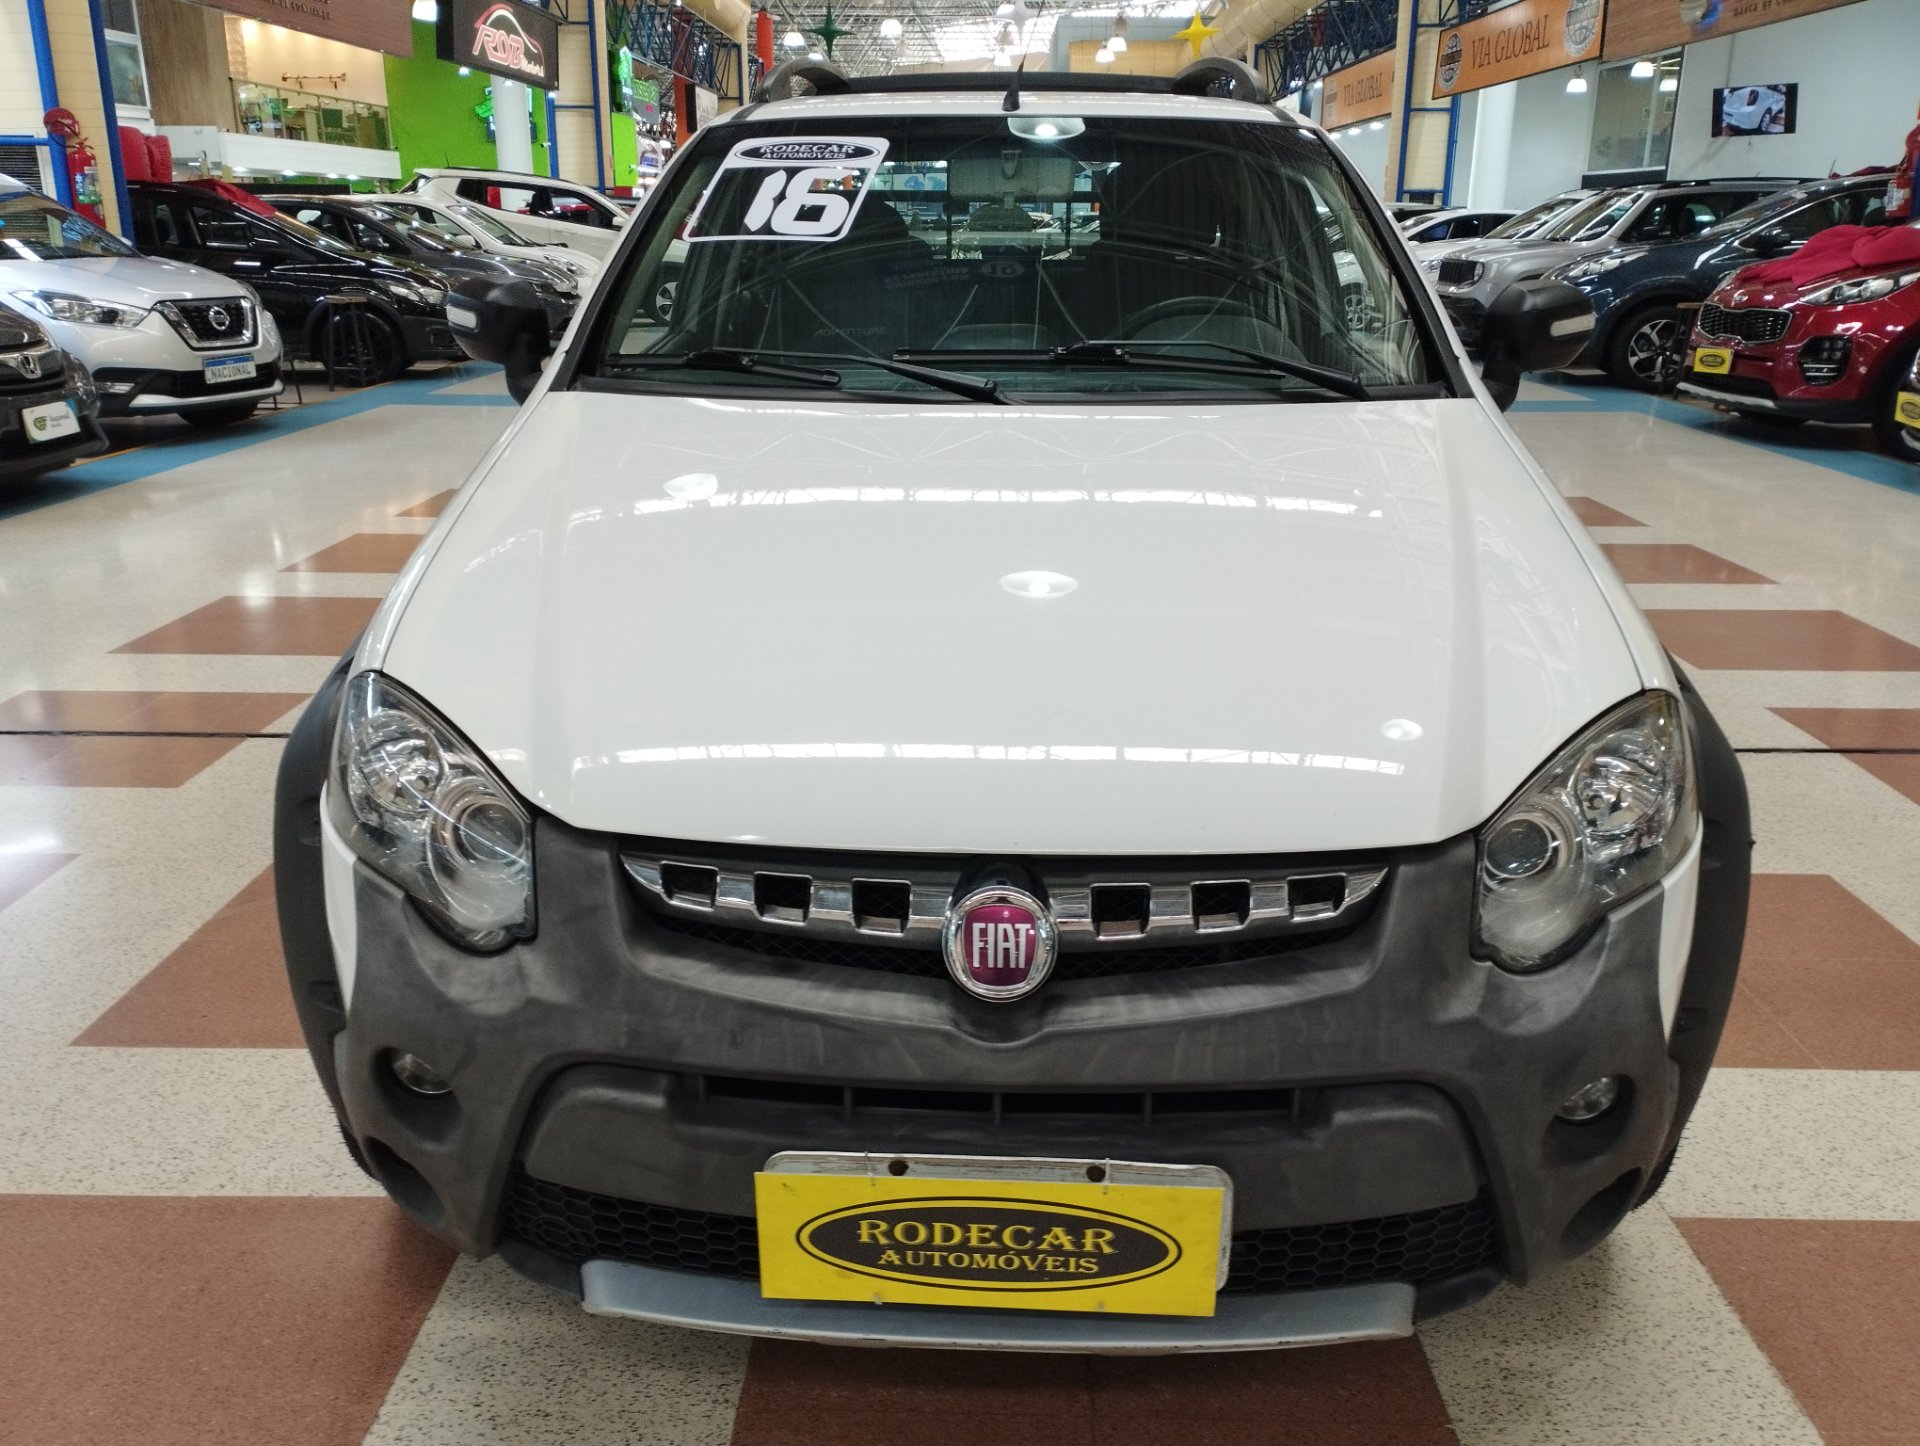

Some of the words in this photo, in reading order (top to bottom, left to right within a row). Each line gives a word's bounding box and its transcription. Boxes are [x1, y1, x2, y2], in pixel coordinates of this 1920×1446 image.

[1472, 36, 1492, 69] VIA
[1495, 14, 1550, 63] GLOBAL
[759, 144, 856, 154] RODECAR
[744, 168, 850, 236] 16
[211, 364, 251, 379] NACIONAL
[972, 922, 1031, 968] FIAT
[857, 1219, 1118, 1254] RODECAR
[878, 1249, 1099, 1274] AUTOMÓVEIS
